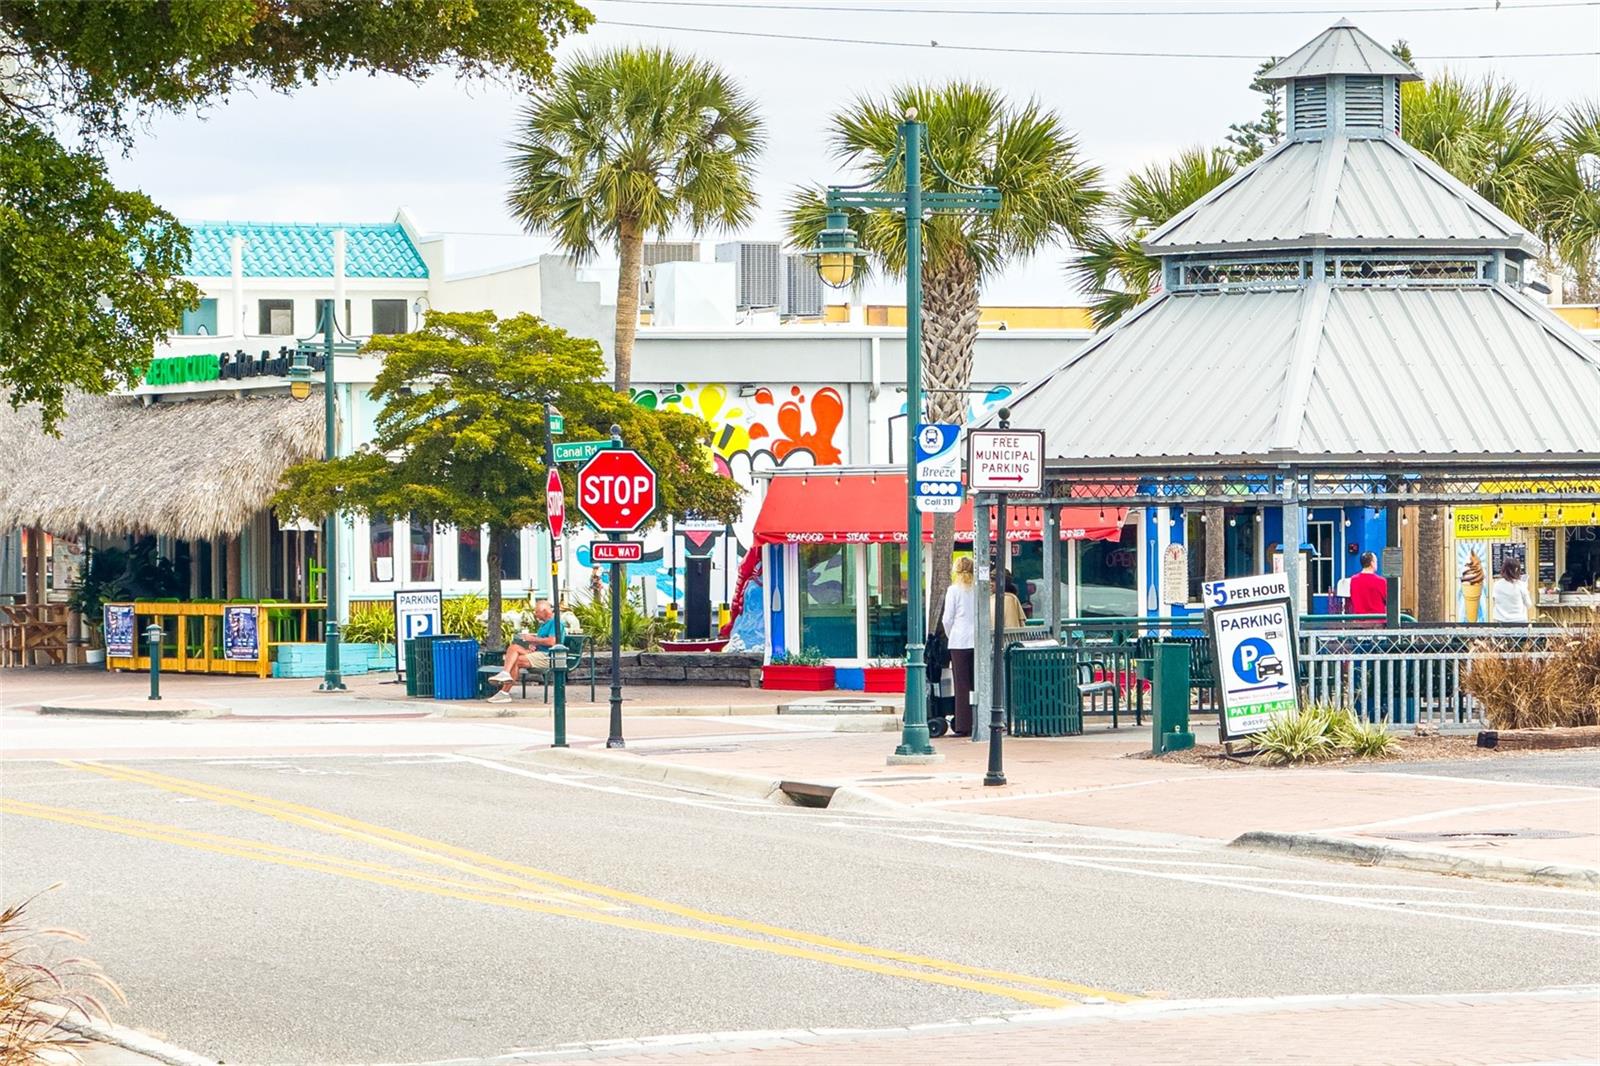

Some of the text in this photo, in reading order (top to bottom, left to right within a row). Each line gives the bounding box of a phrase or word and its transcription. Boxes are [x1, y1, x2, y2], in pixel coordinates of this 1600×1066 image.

[185, 354, 219, 384] CLUB
[993, 438, 1020, 448] FREE
[556, 447, 583, 458] Canal
[976, 451, 1036, 461] MUNICIPAL
[922, 466, 956, 477] Breeze
[982, 463, 1030, 473] PARKING
[584, 475, 650, 505] STOP
[548, 491, 563, 516] STOP
[924, 498, 954, 506] Call 311
[1457, 514, 1479, 523] FRESH
[1458, 523, 1479, 531] FRESH
[786, 532, 824, 541] SEAFOOD
[846, 532, 870, 541] STEAK
[1006, 530, 1031, 539] UNCH
[598, 547, 637, 557] ALL WAY
[400, 594, 439, 605] PARKING
[1204, 582, 1286, 606] $5 PER HOUR
[1221, 612, 1283, 632] PARKING
[1231, 706, 1248, 716] PAY
[1249, 704, 1263, 713] BY
